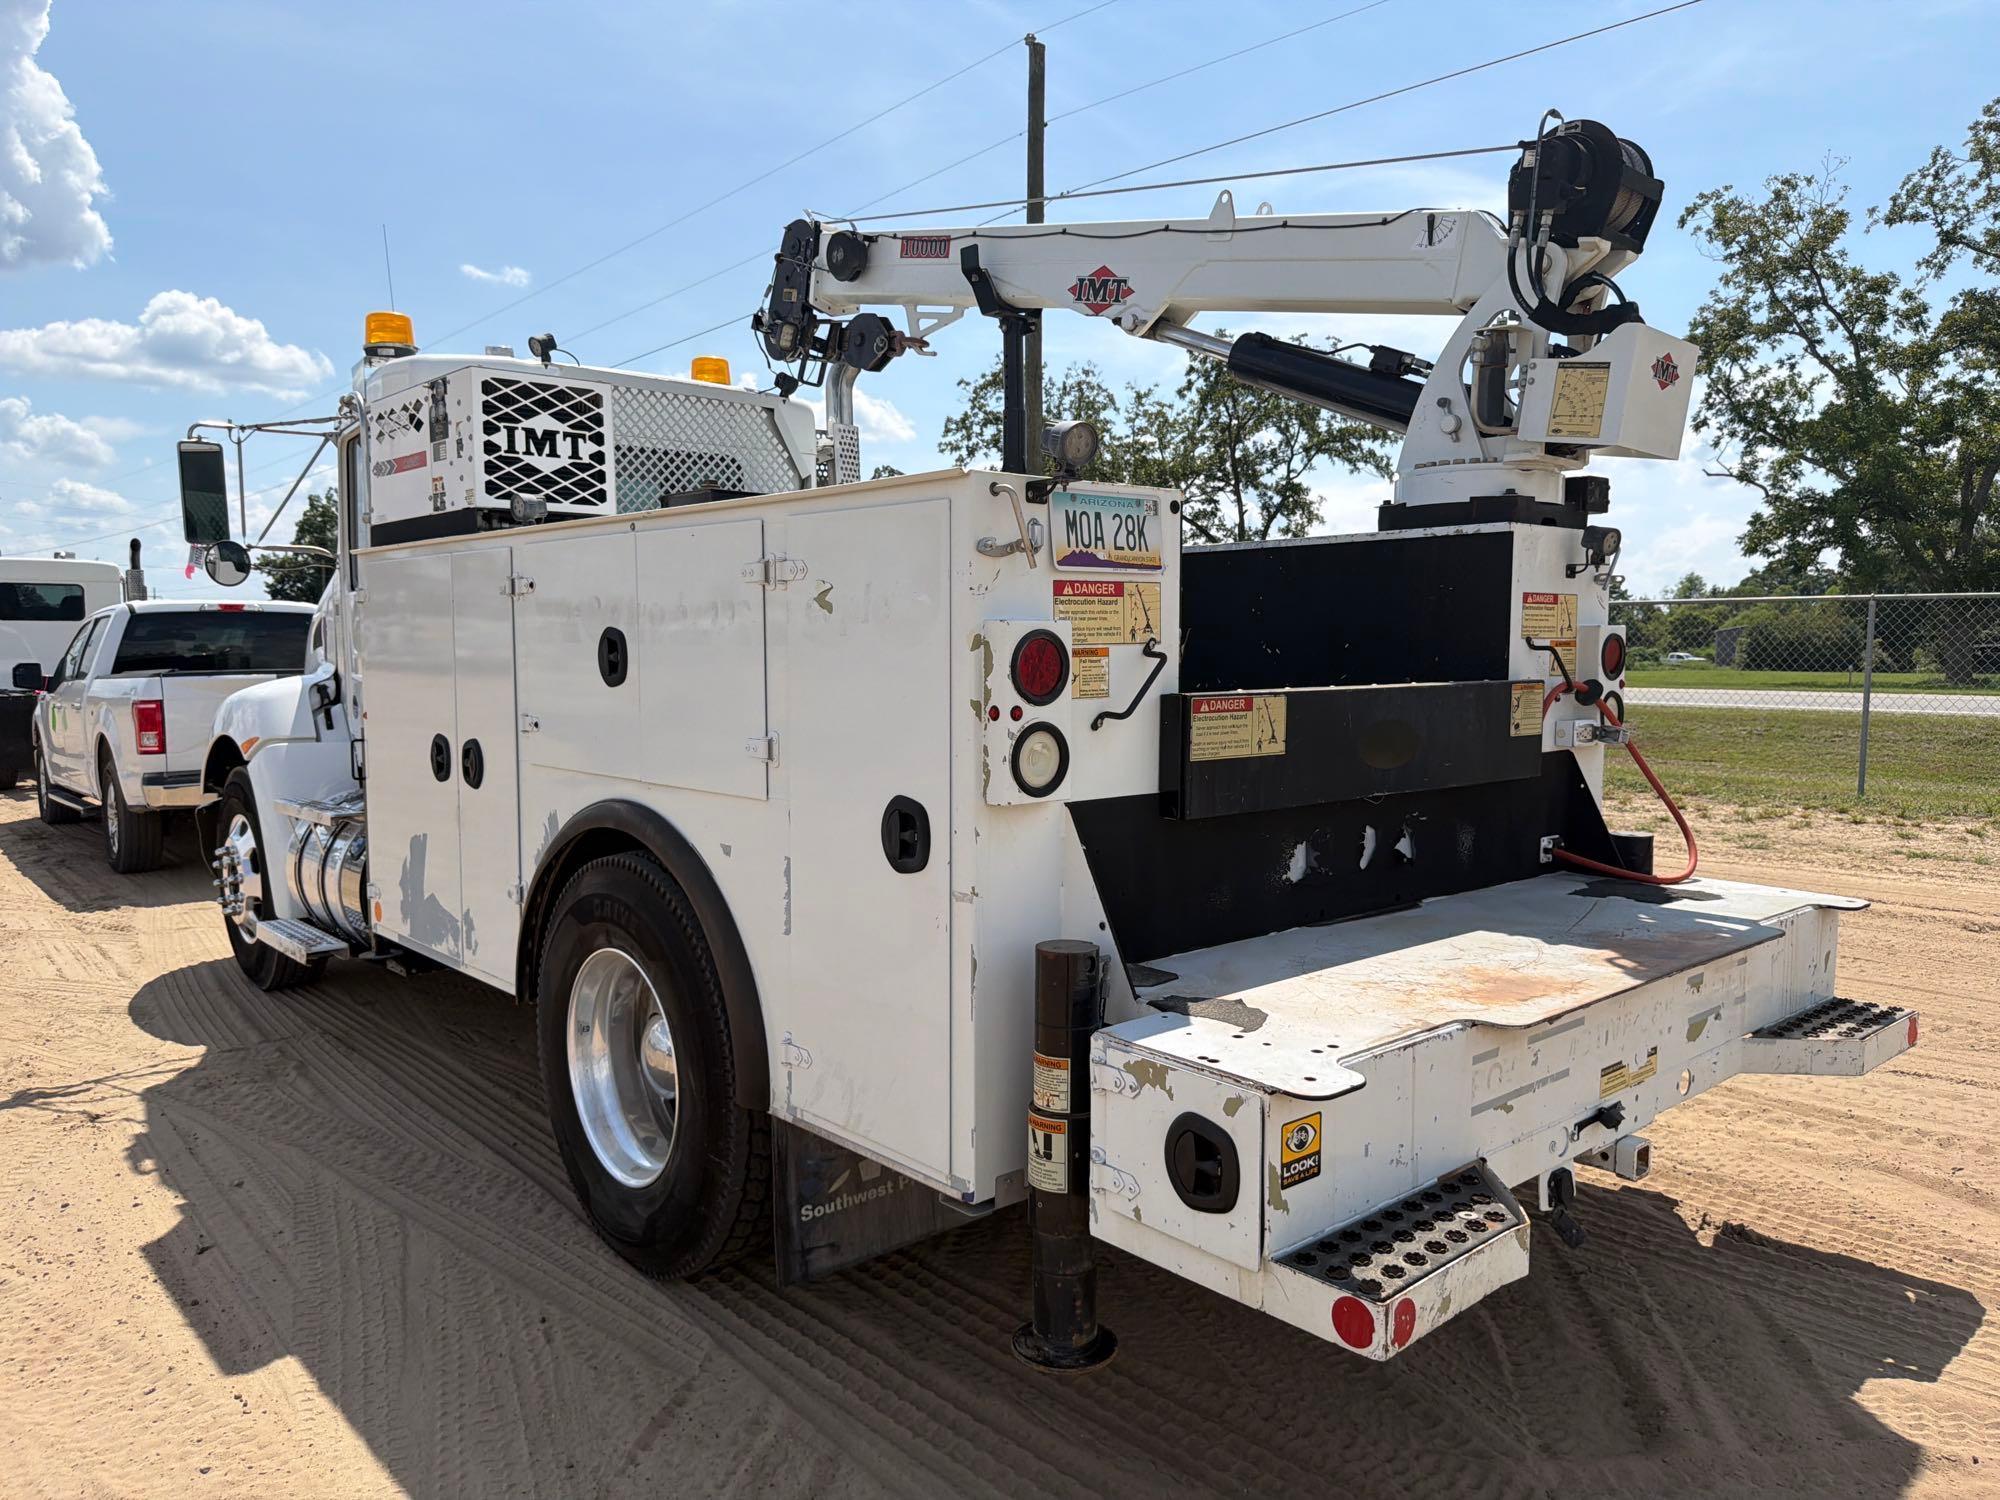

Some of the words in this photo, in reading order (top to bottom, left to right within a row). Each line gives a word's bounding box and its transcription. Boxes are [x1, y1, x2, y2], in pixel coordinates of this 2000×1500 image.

[902, 238, 948, 257] 10000
[1074, 277, 1129, 304] IMT
[1652, 355, 1679, 386] IMT
[501, 424, 589, 461] IMT
[1079, 498, 1134, 509] ARIZONA
[1064, 509, 1106, 550] MOA
[1112, 513, 1149, 552] 28K
[1074, 582, 1115, 594] DANGER
[1054, 597, 1096, 606] Electrocution
[1097, 598, 1118, 606] Hazard
[1532, 594, 1554, 603] DANGER
[1210, 699, 1246, 711] DANGER
[1193, 714, 1229, 723] Electrocution
[1229, 713, 1248, 721] Hazard
[1283, 1154, 1319, 1178] LOOK!
[800, 1180, 895, 1222] Southwest
